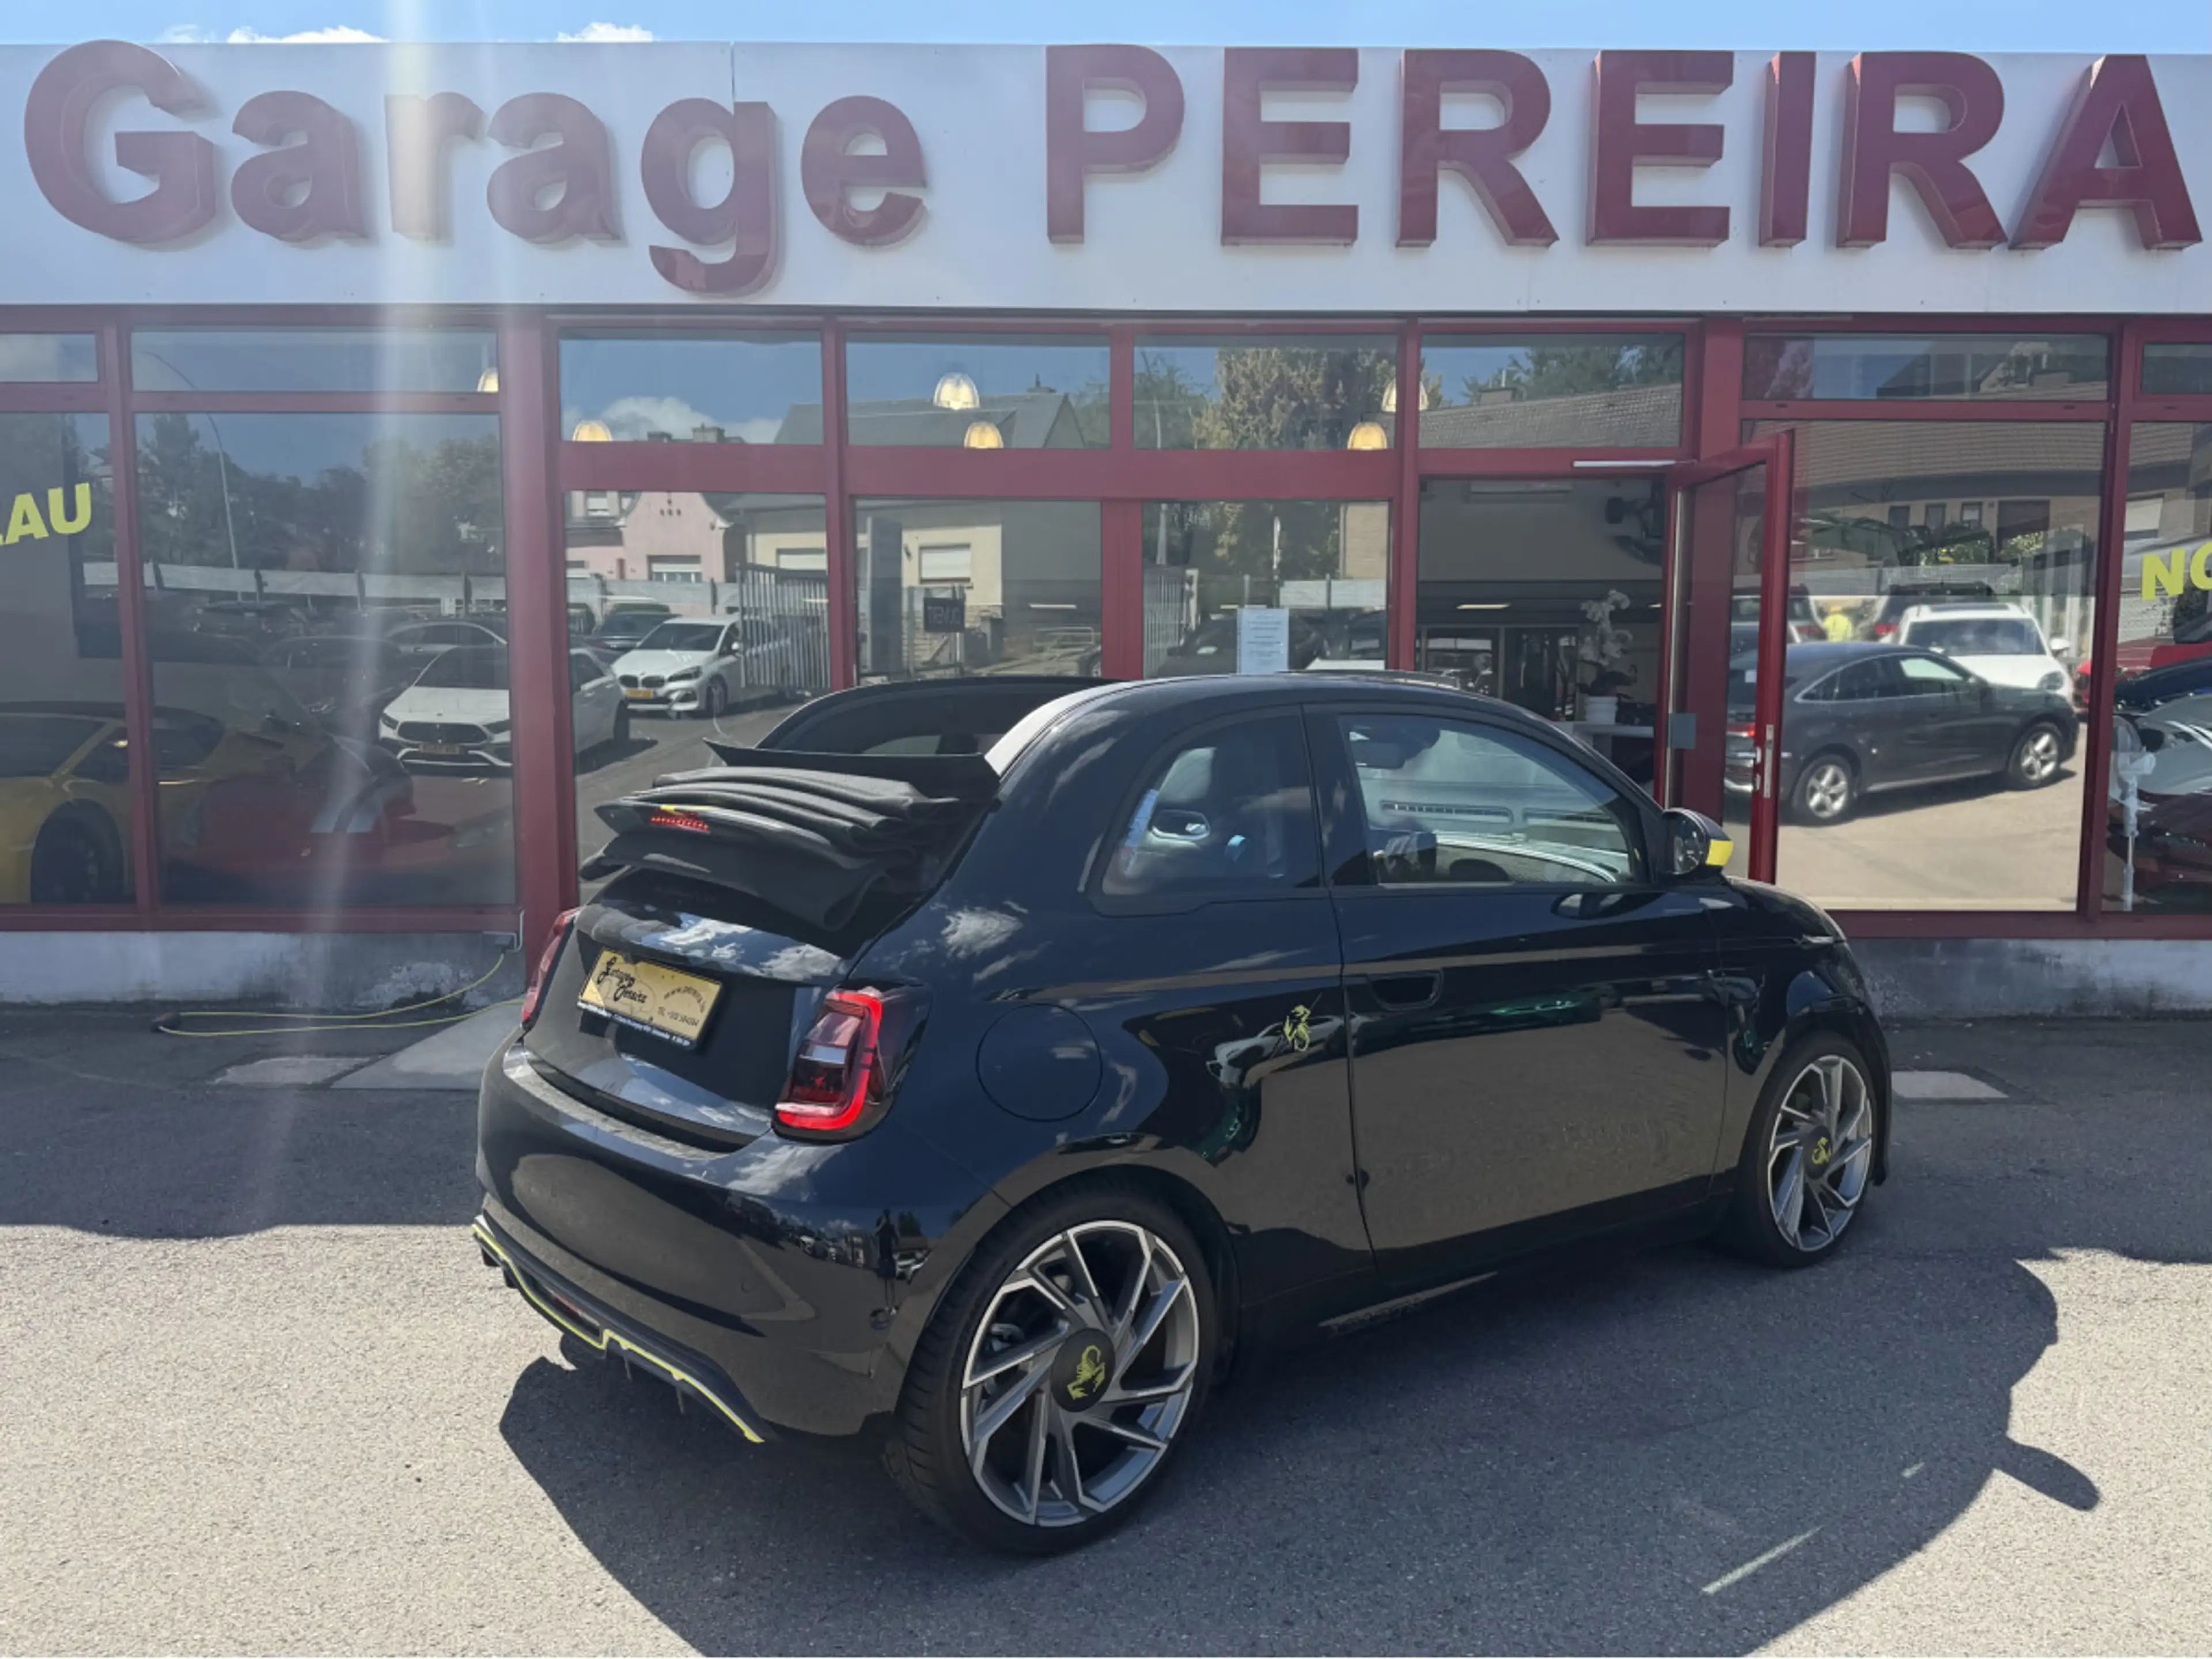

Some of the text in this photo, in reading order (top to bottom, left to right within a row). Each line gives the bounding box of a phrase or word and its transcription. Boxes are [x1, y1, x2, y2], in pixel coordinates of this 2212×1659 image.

[24, 39, 2202, 296] Garage PEREIRA
[0, 482, 91, 546] AU
